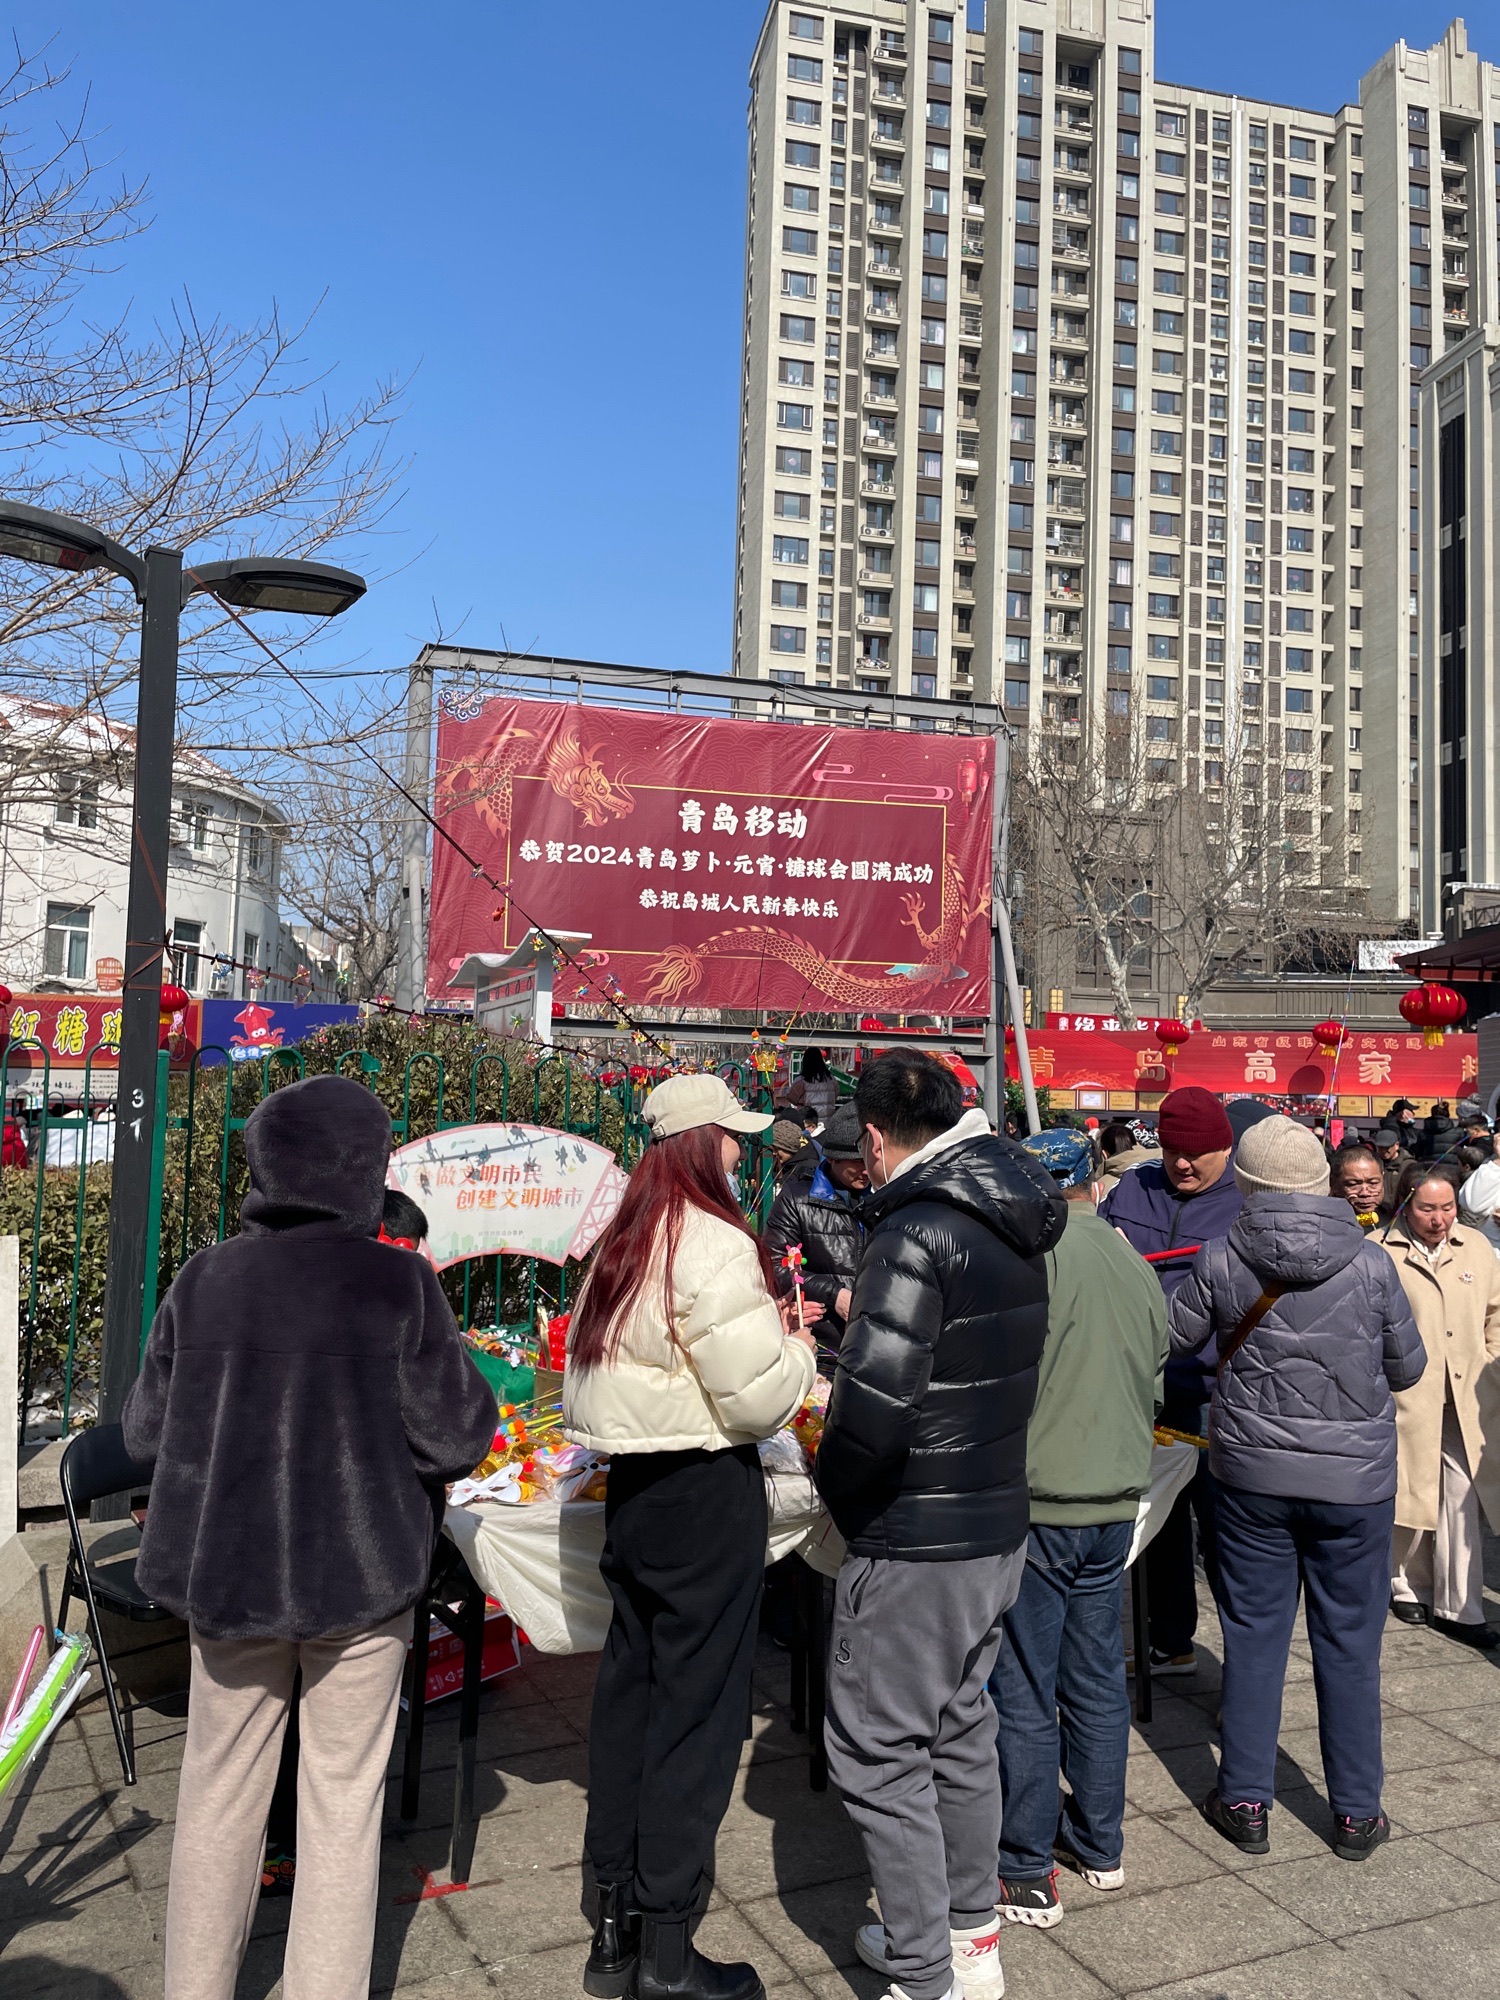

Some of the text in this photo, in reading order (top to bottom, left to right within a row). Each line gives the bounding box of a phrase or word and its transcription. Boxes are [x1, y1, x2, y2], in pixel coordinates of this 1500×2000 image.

[678, 799, 808, 839] 青岛移动
[519, 838, 935, 884] 恭贺2024青岛萝卜·元宵·糖球会圆满成功
[639, 889, 840, 919] 恭祝岛城人民新春快乐
[1211, 1034, 1443, 1051] 山东省级非文化遗
[132, 1089, 144, 1108] 3
[413, 1164, 543, 1186] 争做文明市民
[456, 1187, 584, 1210] 创建文明城市
